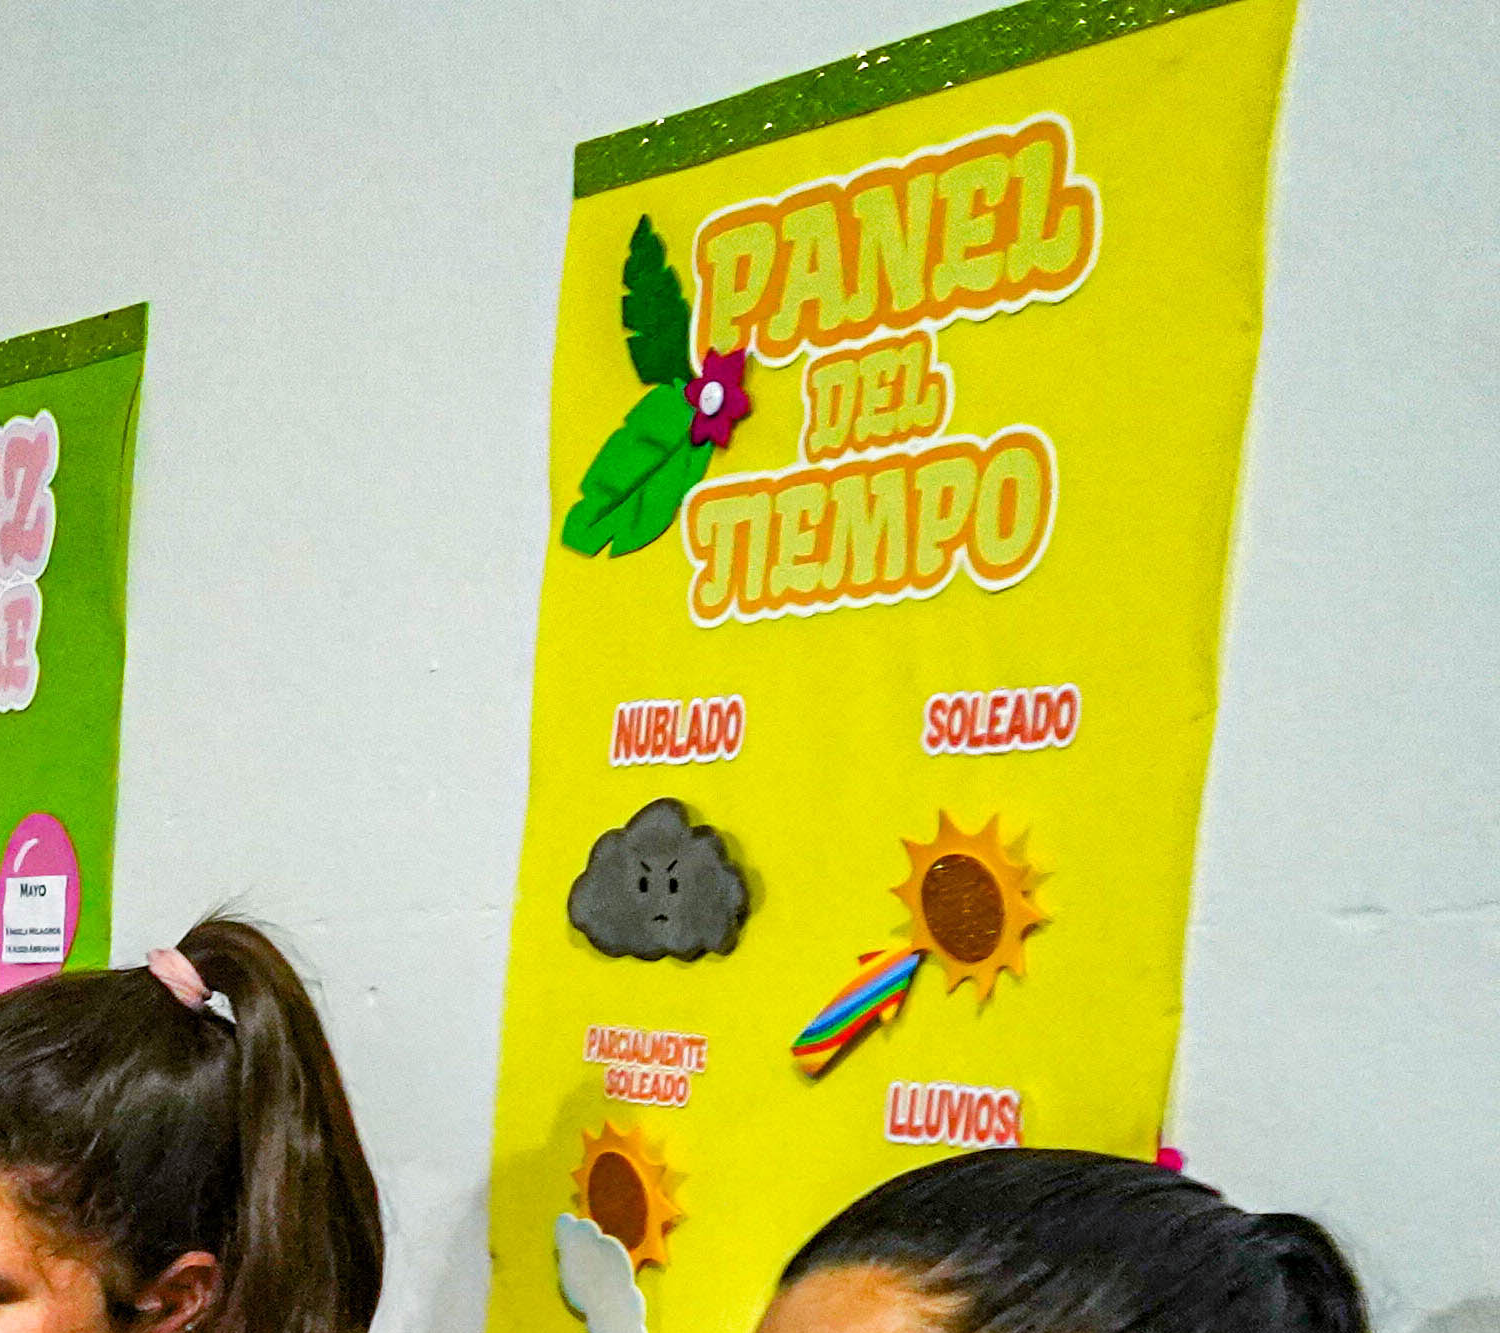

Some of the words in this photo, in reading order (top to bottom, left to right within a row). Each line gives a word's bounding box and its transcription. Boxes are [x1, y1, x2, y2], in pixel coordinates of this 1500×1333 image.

[706, 140, 1082, 353] PANEL
[809, 345, 945, 455] DEL
[698, 447, 1045, 606] TIEMPO
[613, 701, 743, 760] NUBLADO
[926, 687, 1078, 749] SOLEADO
[20, 883, 47, 898] MAYO
[587, 1027, 707, 1070] PARCIALMENTE
[604, 1067, 689, 1103] SOLEADO
